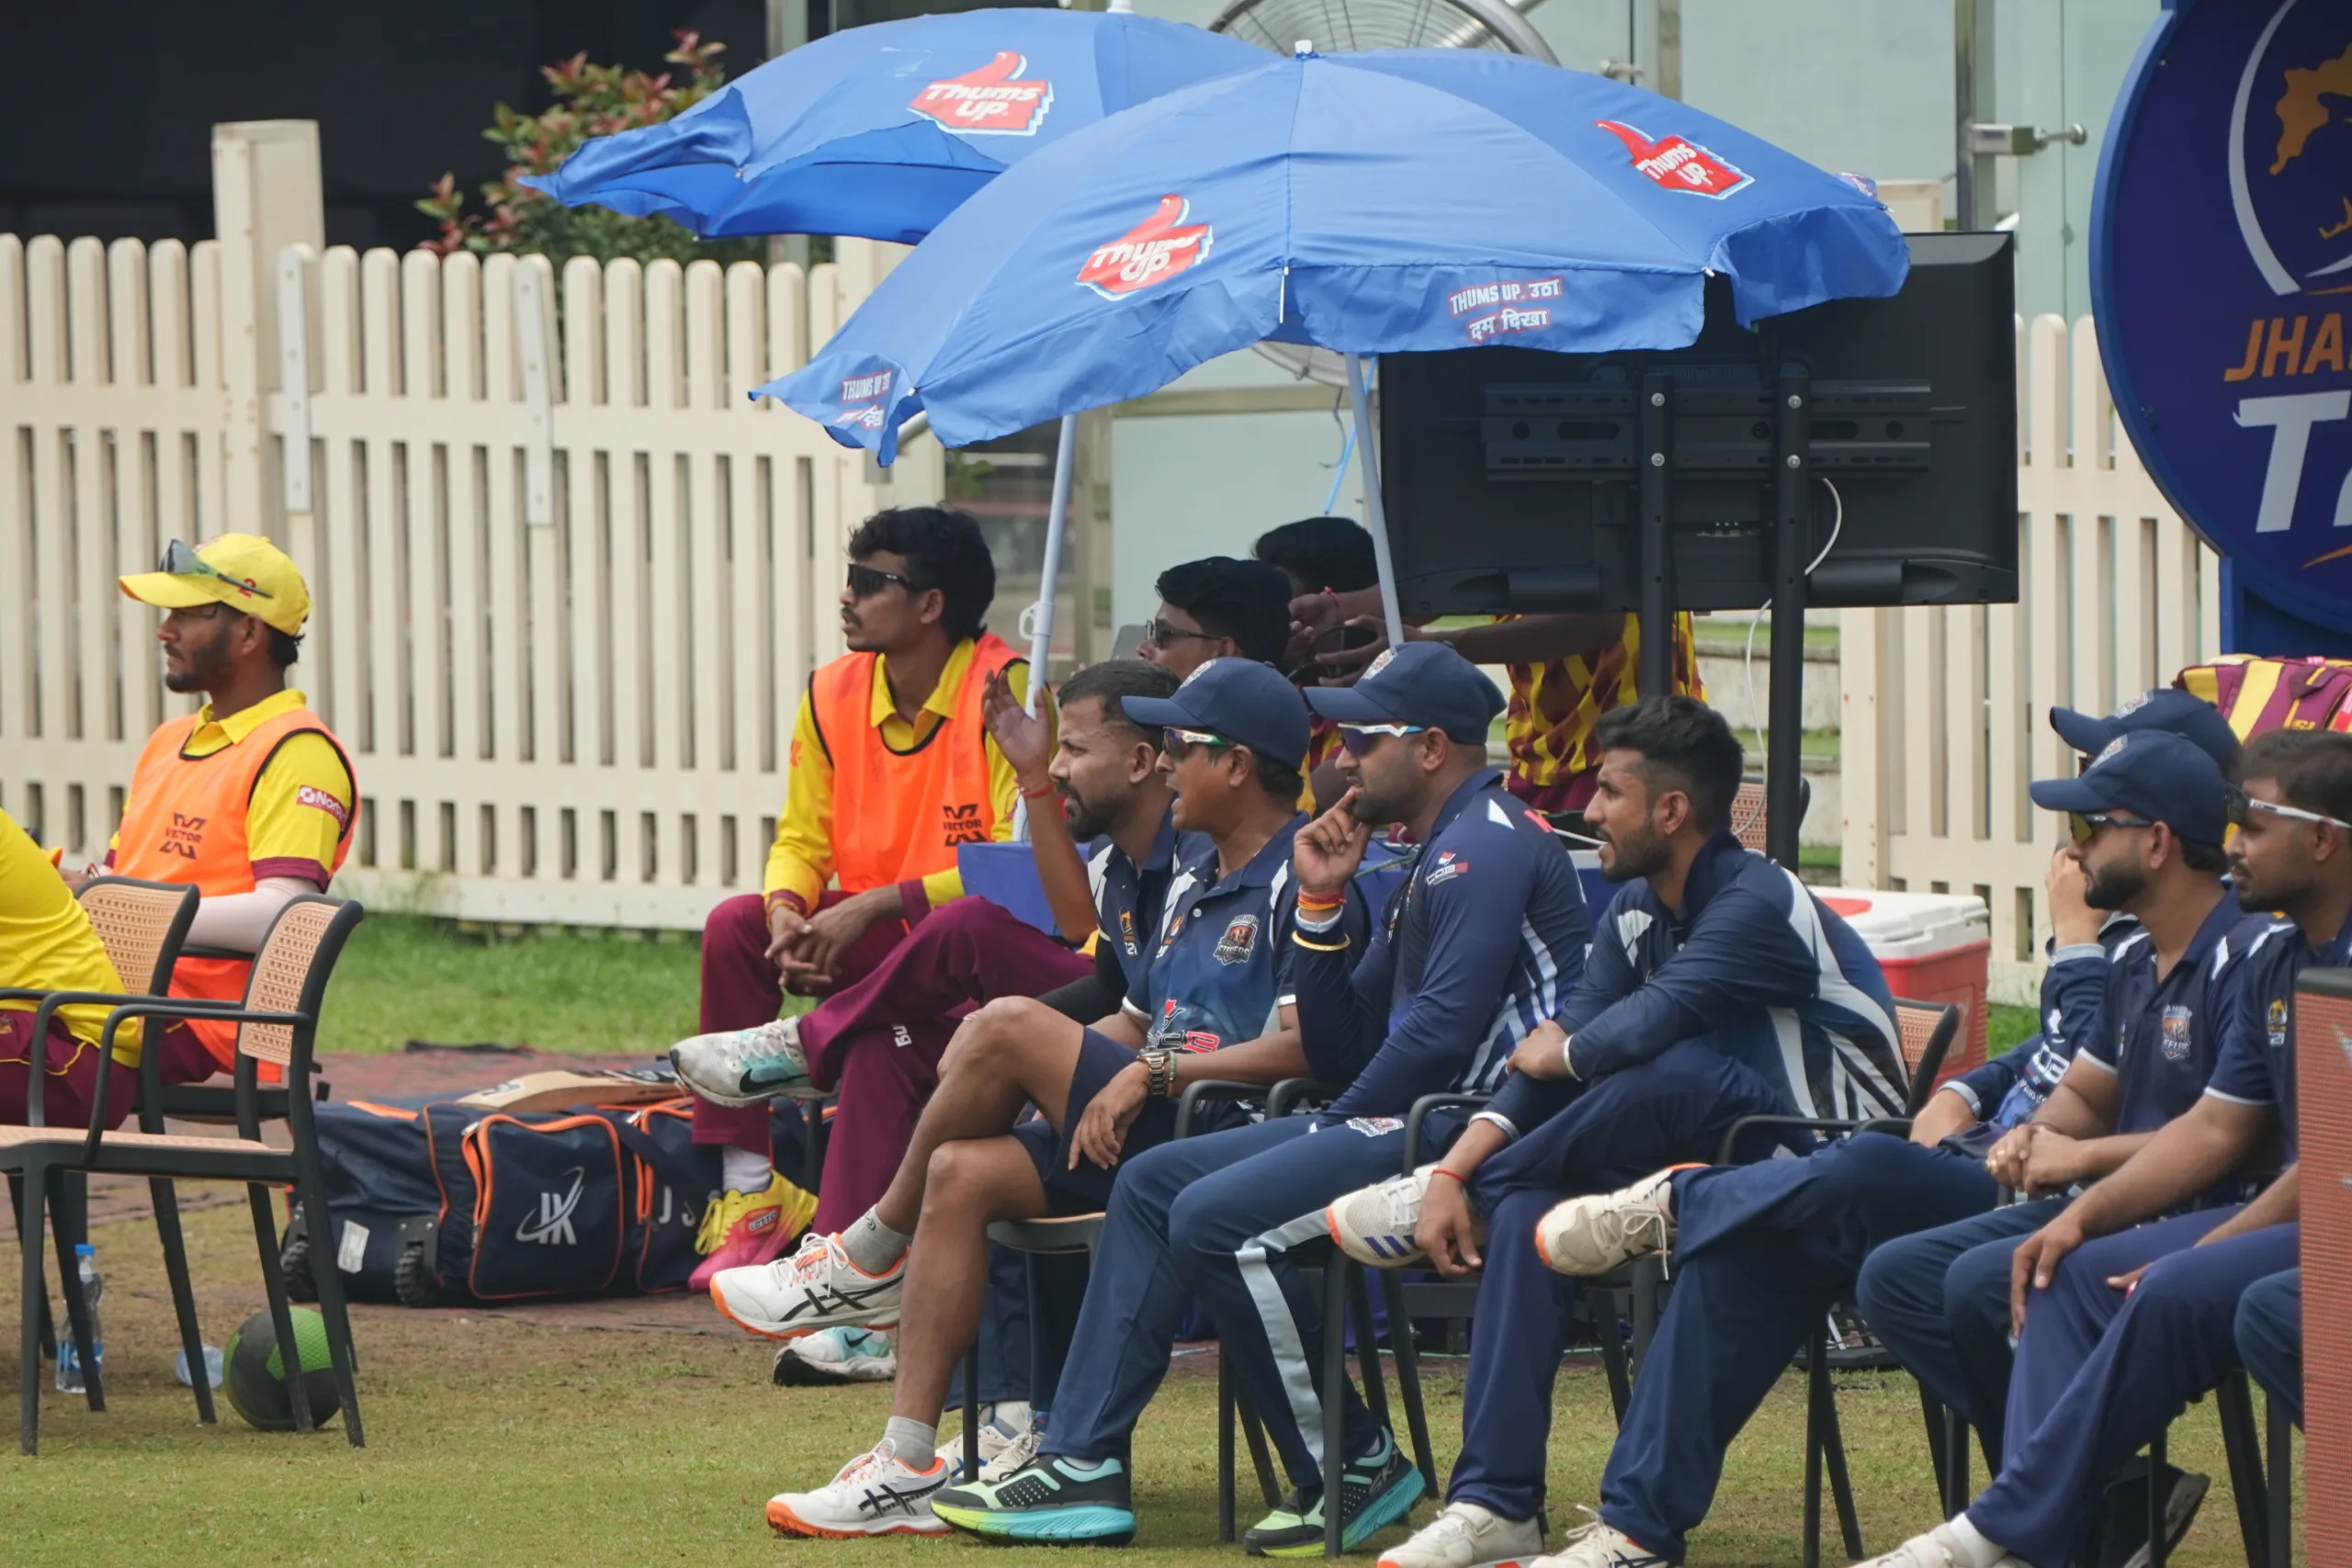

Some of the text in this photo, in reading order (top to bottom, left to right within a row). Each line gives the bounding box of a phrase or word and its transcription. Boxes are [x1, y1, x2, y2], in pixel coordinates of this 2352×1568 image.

[1451, 285, 1499, 314] THUMS
[1469, 309, 1547, 341] दम दिखा
[2224, 313, 2352, 381] JHA
[2233, 389, 2352, 533] T
